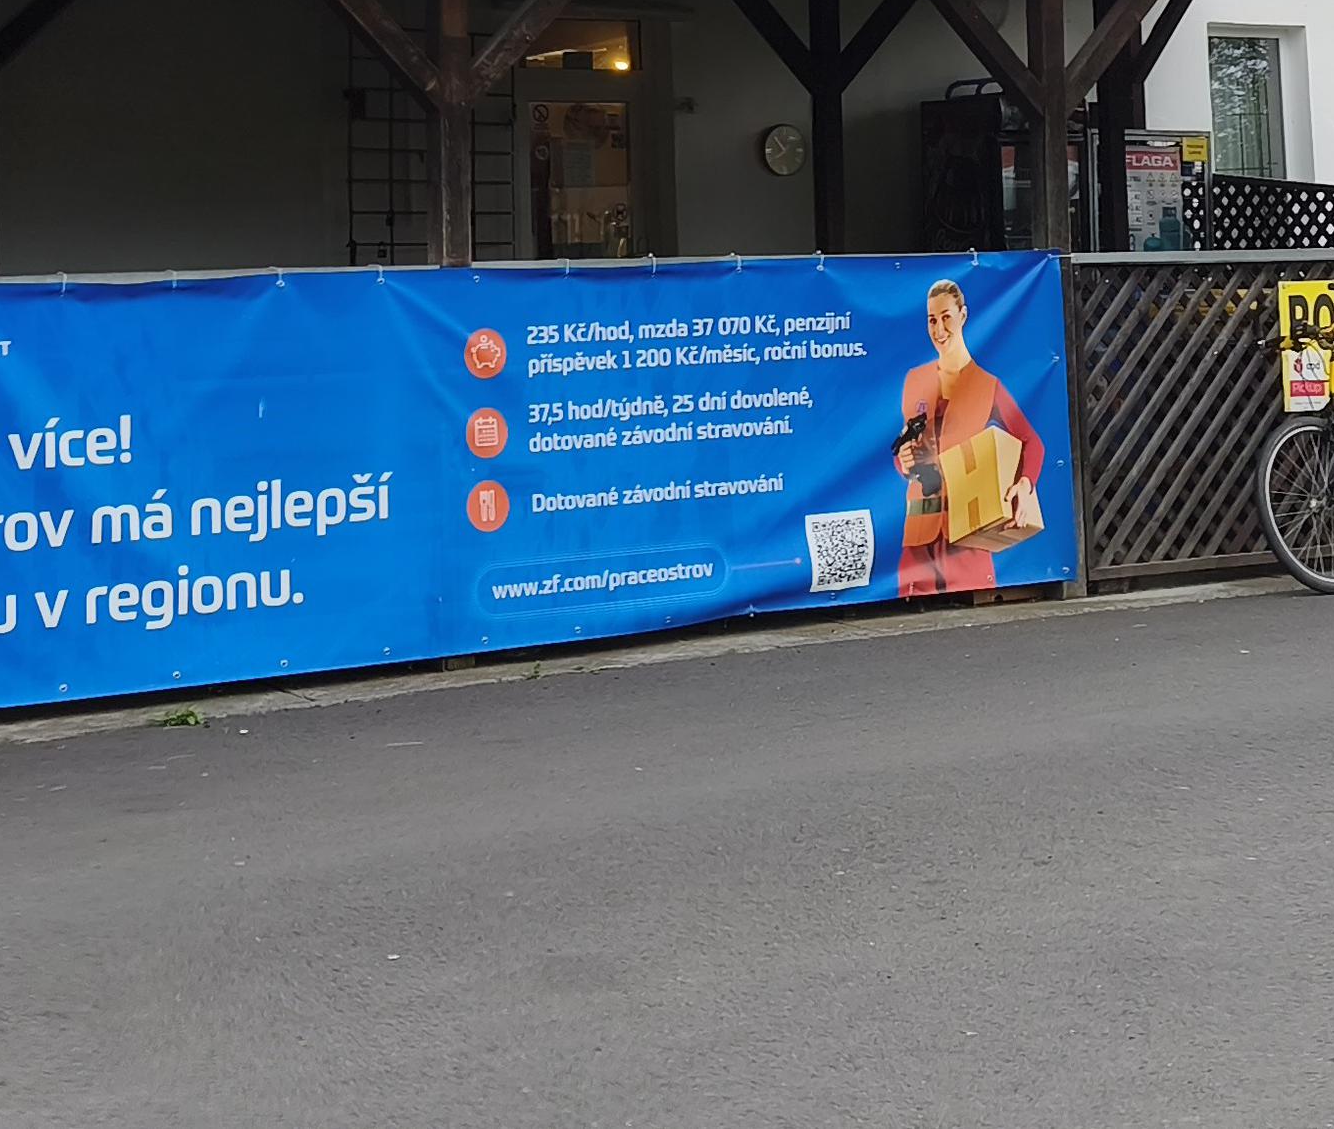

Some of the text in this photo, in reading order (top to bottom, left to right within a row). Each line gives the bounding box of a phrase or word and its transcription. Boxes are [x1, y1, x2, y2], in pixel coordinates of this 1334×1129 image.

[527, 325, 560, 345] 235
[564, 320, 634, 343] Kč/hod,
[638, 318, 688, 339] mzda
[692, 318, 714, 337] 37
[718, 316, 751, 336] 070
[754, 314, 780, 336] Kč,
[528, 340, 868, 378] příspěvek 1 200 Kč/měsíc, roční bonus.
[528, 387, 813, 425] 37,5 hod/týdně, 25 dní dovolené,
[7, 414, 132, 470] více!
[529, 416, 793, 453] dotované závodní stravování.
[91, 488, 173, 544] má
[191, 471, 393, 544] nejlepší
[532, 473, 783, 512] Dotované závodní stravování
[34, 589, 69, 628] v
[86, 564, 304, 630] regionu.
[492, 561, 713, 600] www.zf.com/praceostrov
